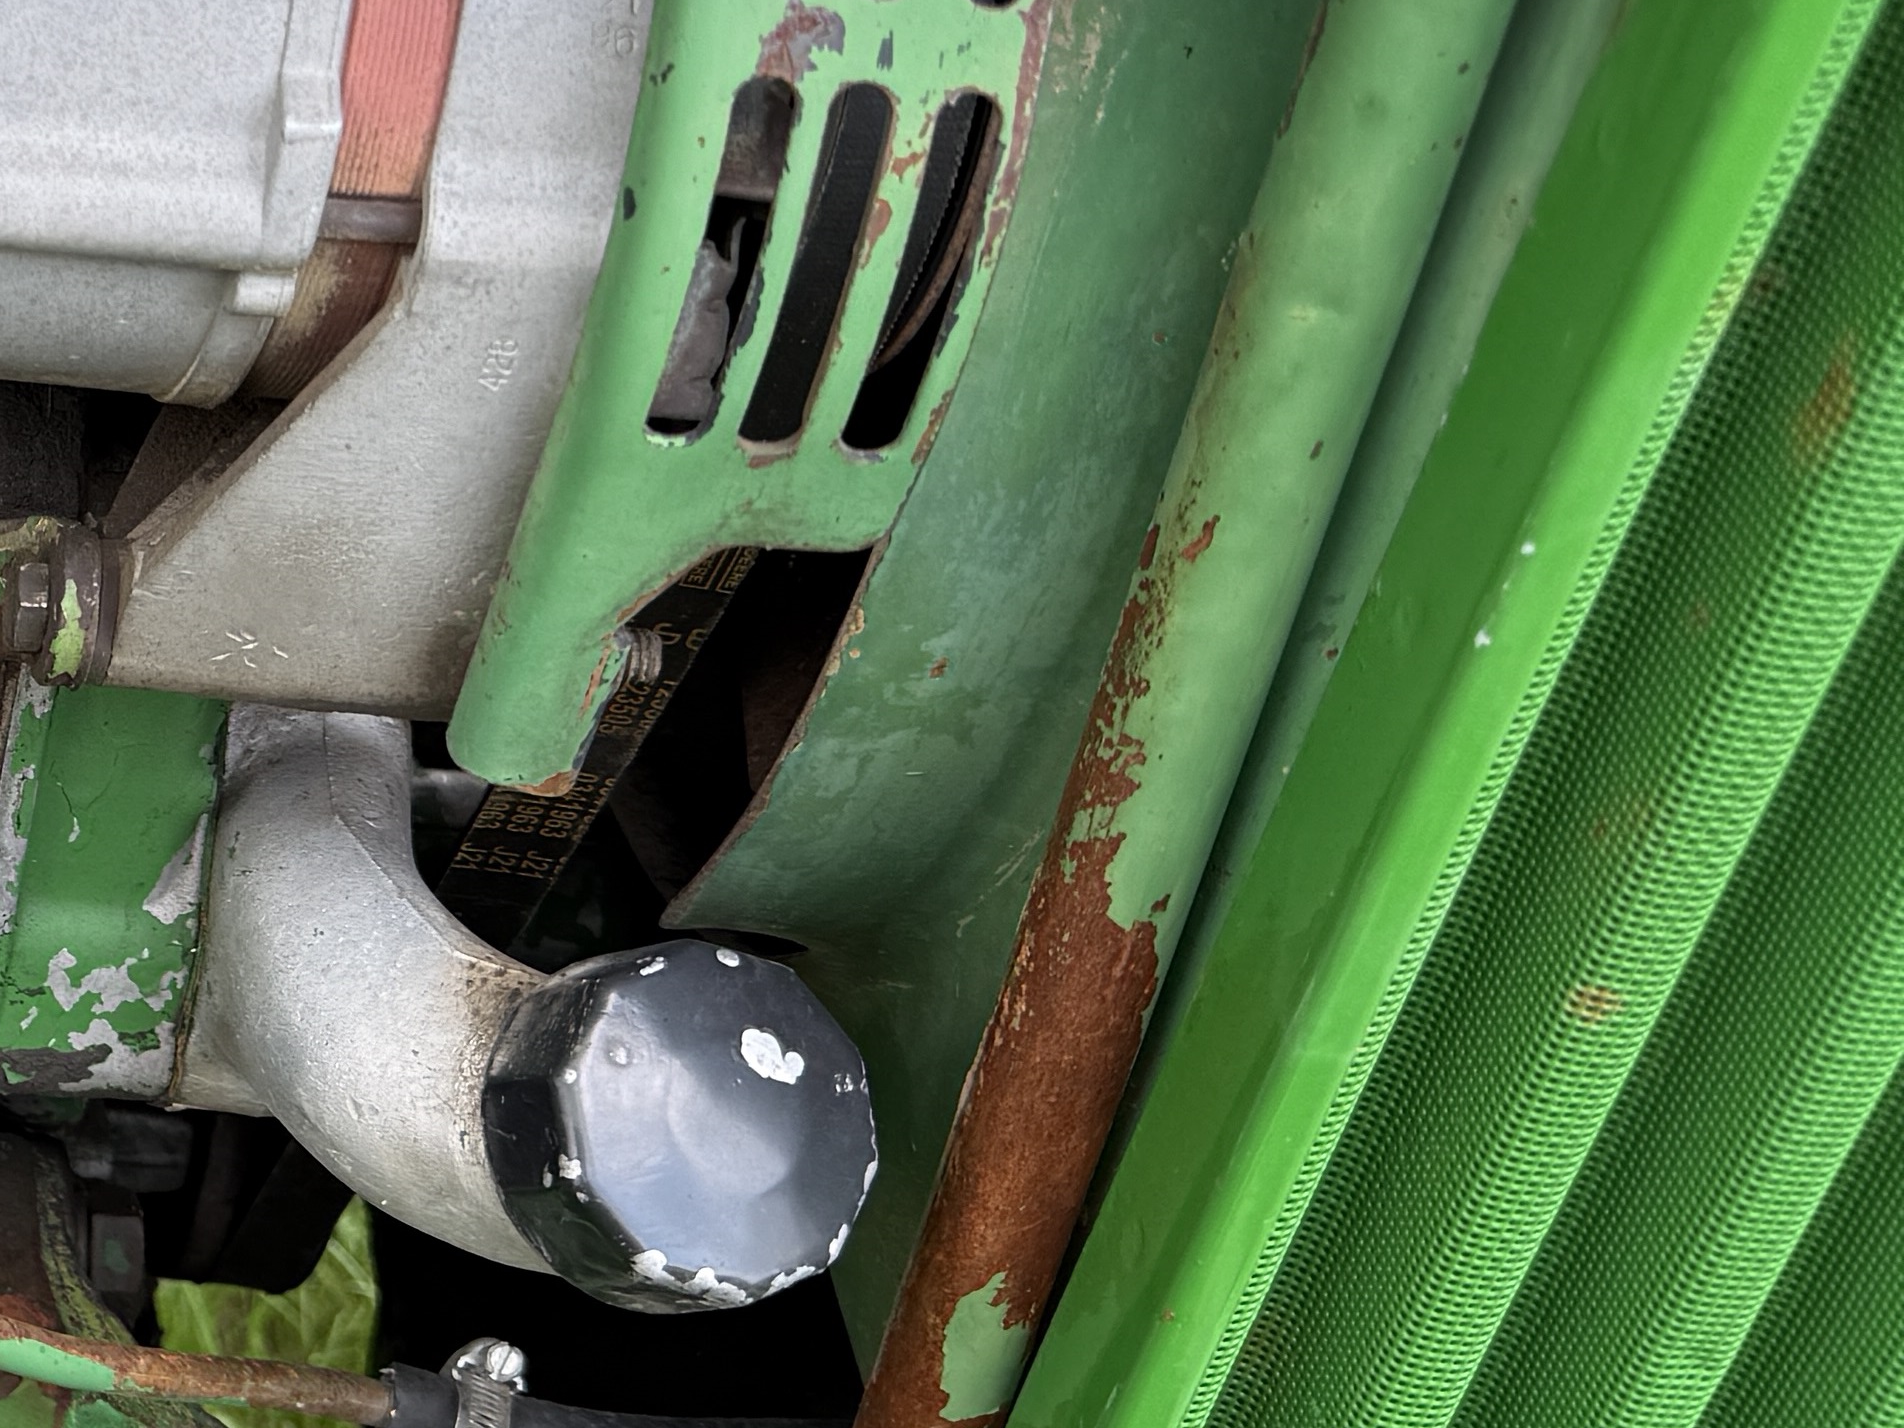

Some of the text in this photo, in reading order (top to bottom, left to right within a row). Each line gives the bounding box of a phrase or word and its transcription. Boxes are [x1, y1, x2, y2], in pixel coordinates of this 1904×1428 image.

[599, 678, 651, 735] 23505
[484, 797, 551, 874] 1963 J21
